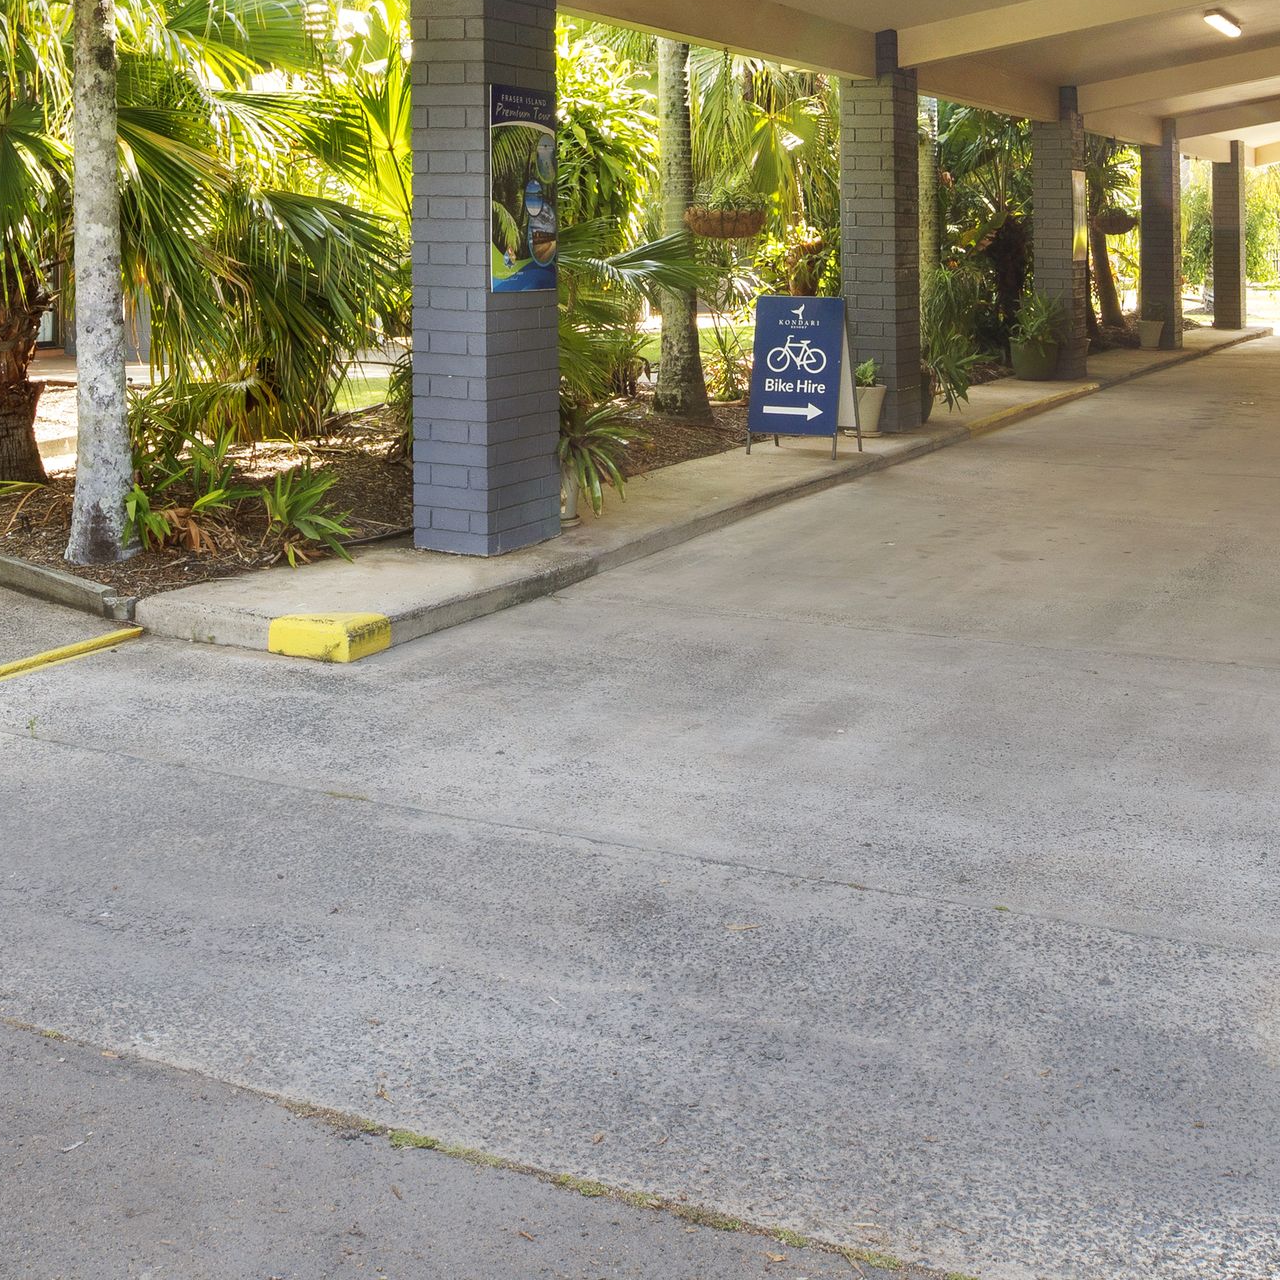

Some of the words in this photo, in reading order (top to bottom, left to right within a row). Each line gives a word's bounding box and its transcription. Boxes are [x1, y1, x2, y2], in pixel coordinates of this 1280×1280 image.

[501, 94, 523, 103] FRASER
[526, 97, 546, 106] ISLAND
[496, 103, 530, 117] Premium
[765, 378, 794, 392] Bike
[797, 380, 826, 393] Hire
